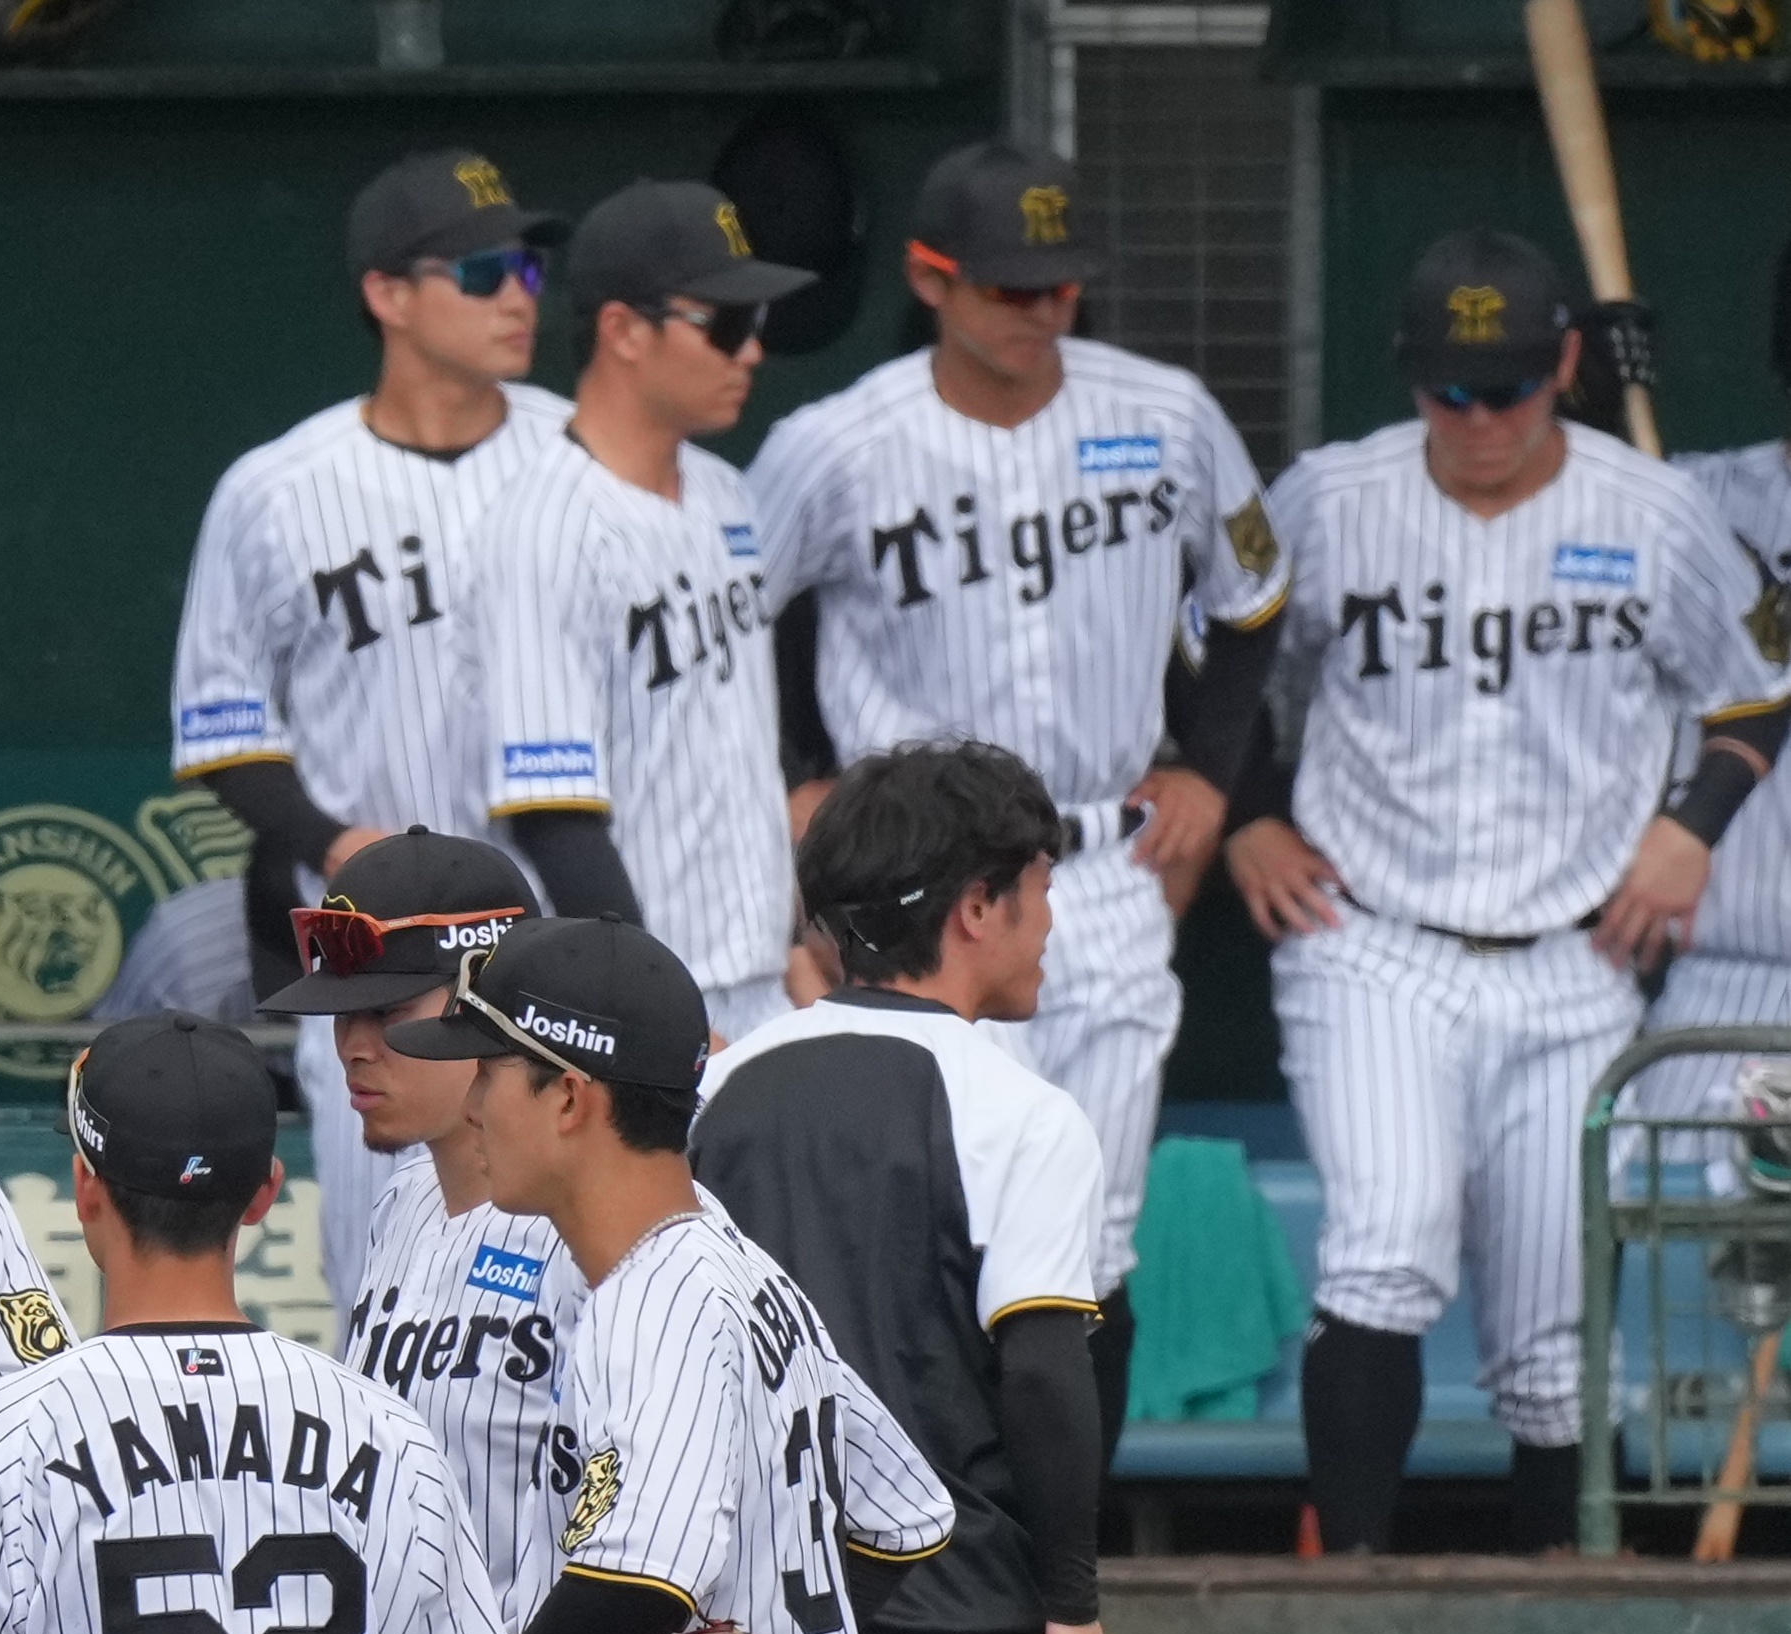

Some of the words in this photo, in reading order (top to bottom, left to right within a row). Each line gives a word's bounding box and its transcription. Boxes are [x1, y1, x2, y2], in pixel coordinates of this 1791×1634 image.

[873, 478, 1177, 608] Tigers
[1342, 582, 1649, 694] Tigers
[515, 1005, 615, 1056] Joshin
[45, 1402, 382, 1525] YAMADA
